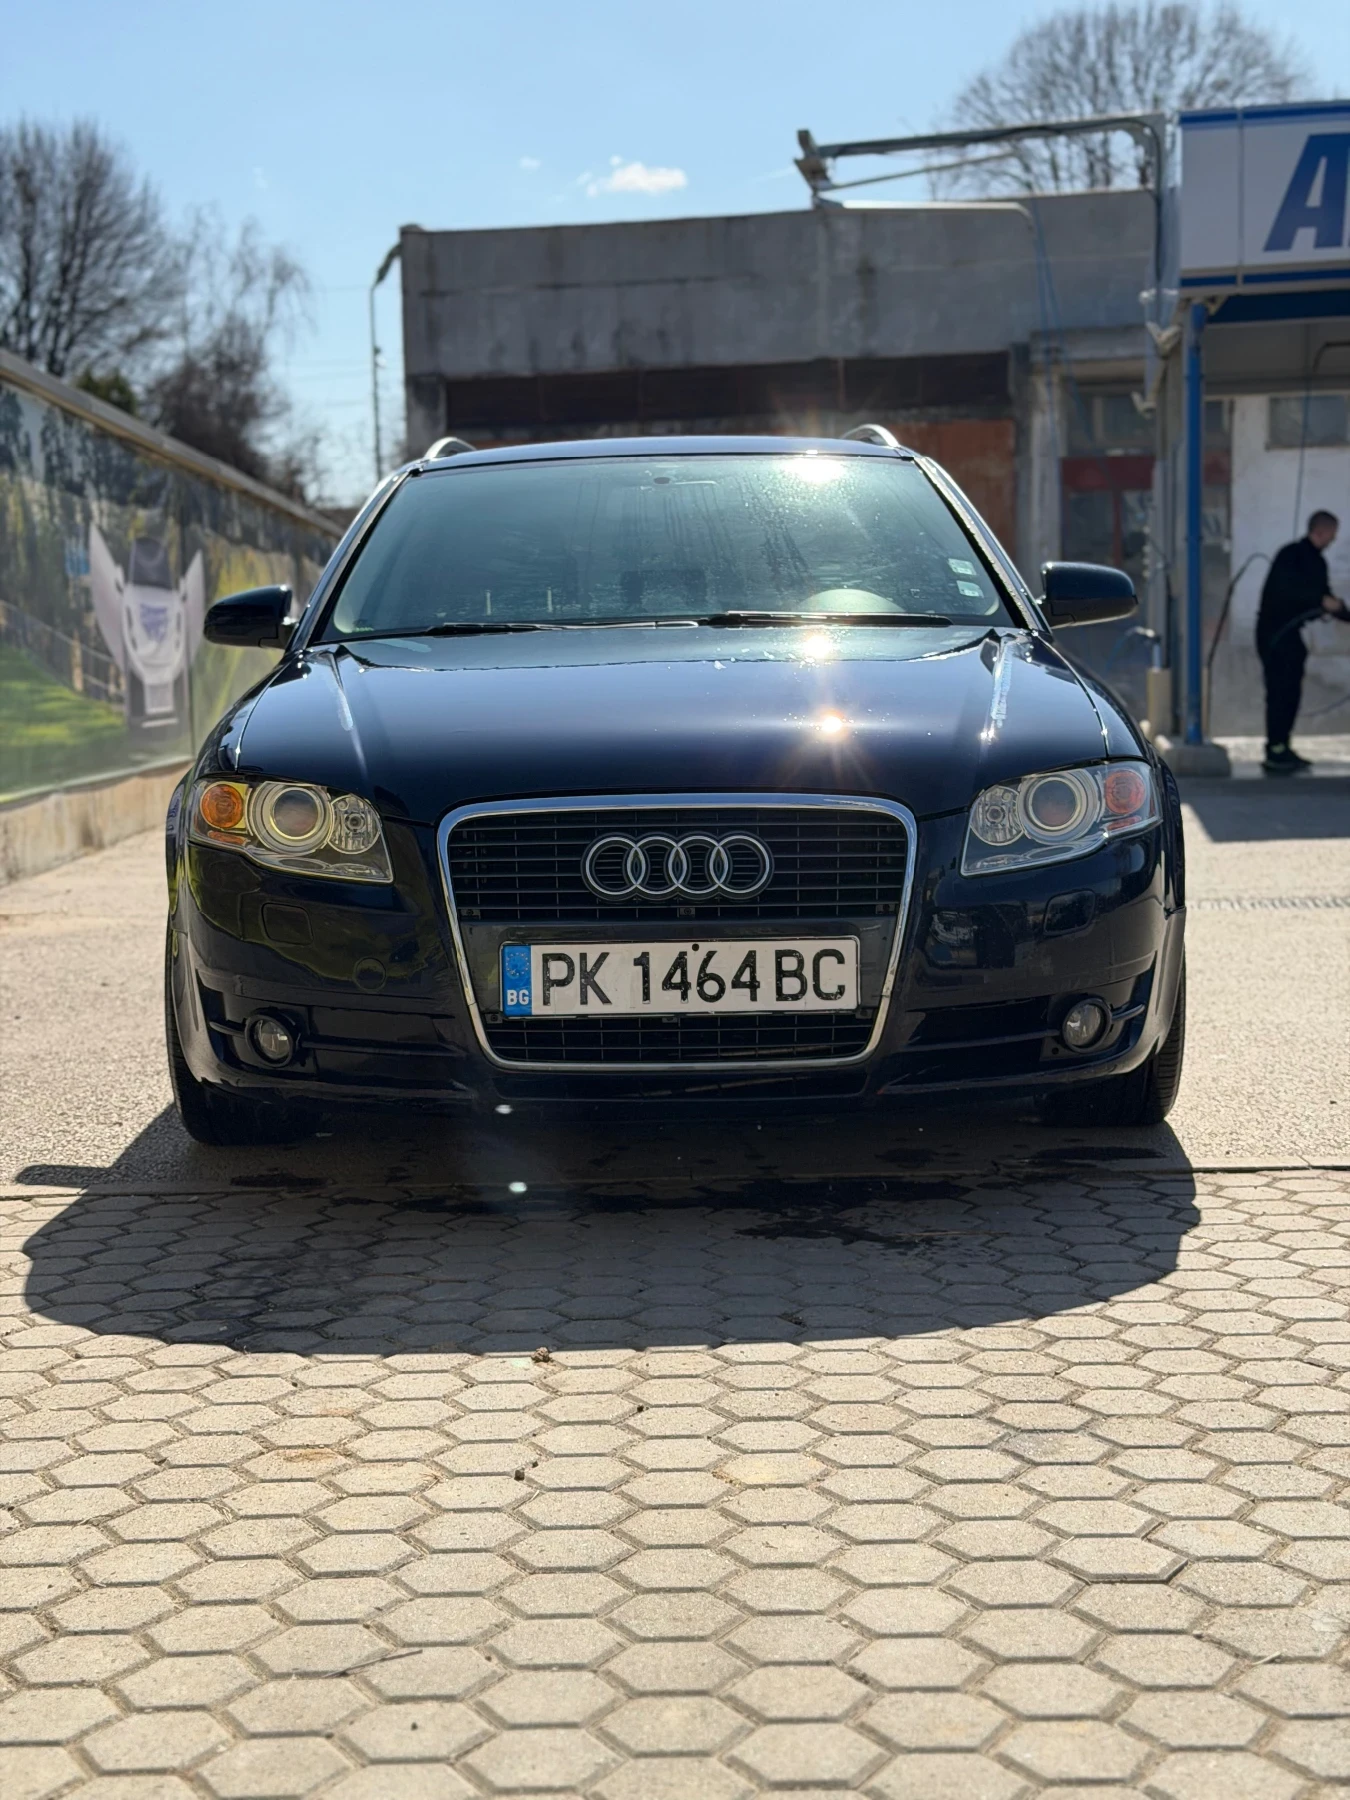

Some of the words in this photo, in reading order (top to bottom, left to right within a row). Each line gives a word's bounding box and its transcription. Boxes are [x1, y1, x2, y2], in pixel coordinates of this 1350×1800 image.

[1263, 133, 1350, 252] A
[507, 990, 529, 1005] BG
[541, 952, 612, 1006] PK
[633, 950, 760, 1004] 1464
[774, 949, 846, 1001] BC
